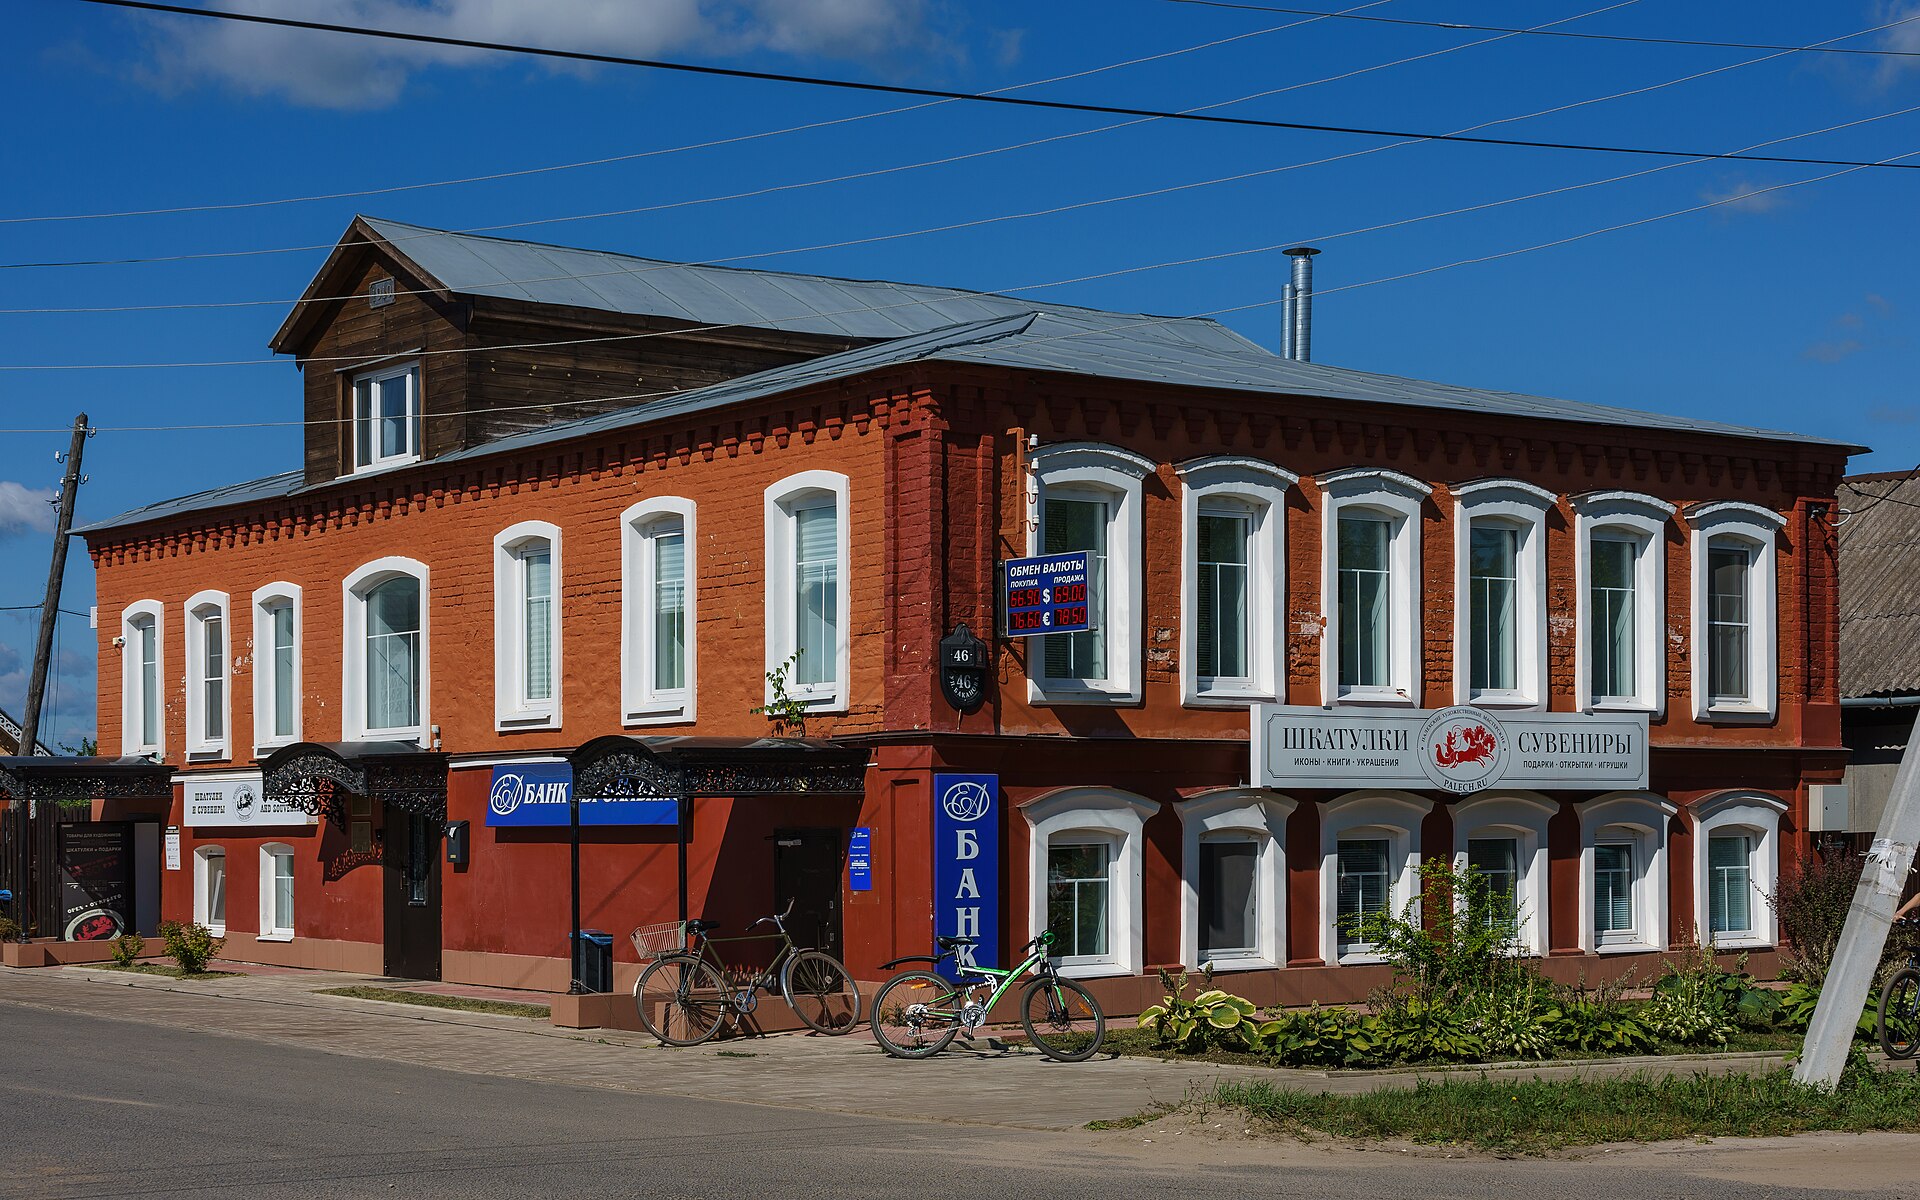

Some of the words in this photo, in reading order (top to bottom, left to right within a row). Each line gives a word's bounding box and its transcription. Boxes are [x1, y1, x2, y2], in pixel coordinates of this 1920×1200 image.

[1010, 564, 1041, 577] ОБМЕН
[1042, 560, 1085, 574] ВАЛЮТЫ
[1010, 579, 1038, 588] ПОКУПКА
[1053, 574, 1084, 584] ПРОДАЖА
[1042, 588, 1051, 604] $
[1042, 612, 1050, 626] €
[953, 649, 969, 661] 46
[956, 674, 971, 689] 46
[1421, 715, 1441, 742] ПАЛЕХСКИЕ
[1441, 709, 1482, 718] ХУДОЖЕСТВЕННЫЕ
[1482, 714, 1506, 744] МАСТЕРСКИЕ
[1282, 727, 1409, 751] ШКАТУЛКИ
[1518, 731, 1632, 754] СУВЕНИРЫ
[1294, 758, 1321, 766] ИКОНЫ
[1326, 758, 1351, 766] КНИГИ
[1356, 758, 1399, 767] УКРАШЕНИЯ
[1523, 760, 1554, 769] ПОДАРКИ
[1559, 760, 1593, 769] ОТКРЫТКИ
[1598, 761, 1628, 769] ИГРУШКИ
[1443, 778, 1488, 792] PALECH.RU
[194, 792, 222, 801] ШКАТУЛКИ
[523, 783, 569, 804] БАНК
[191, 806, 196, 814] И
[197, 805, 225, 814] СУВЕНИРЫ
[260, 804, 271, 812] AND
[955, 829, 980, 975] БАНК
